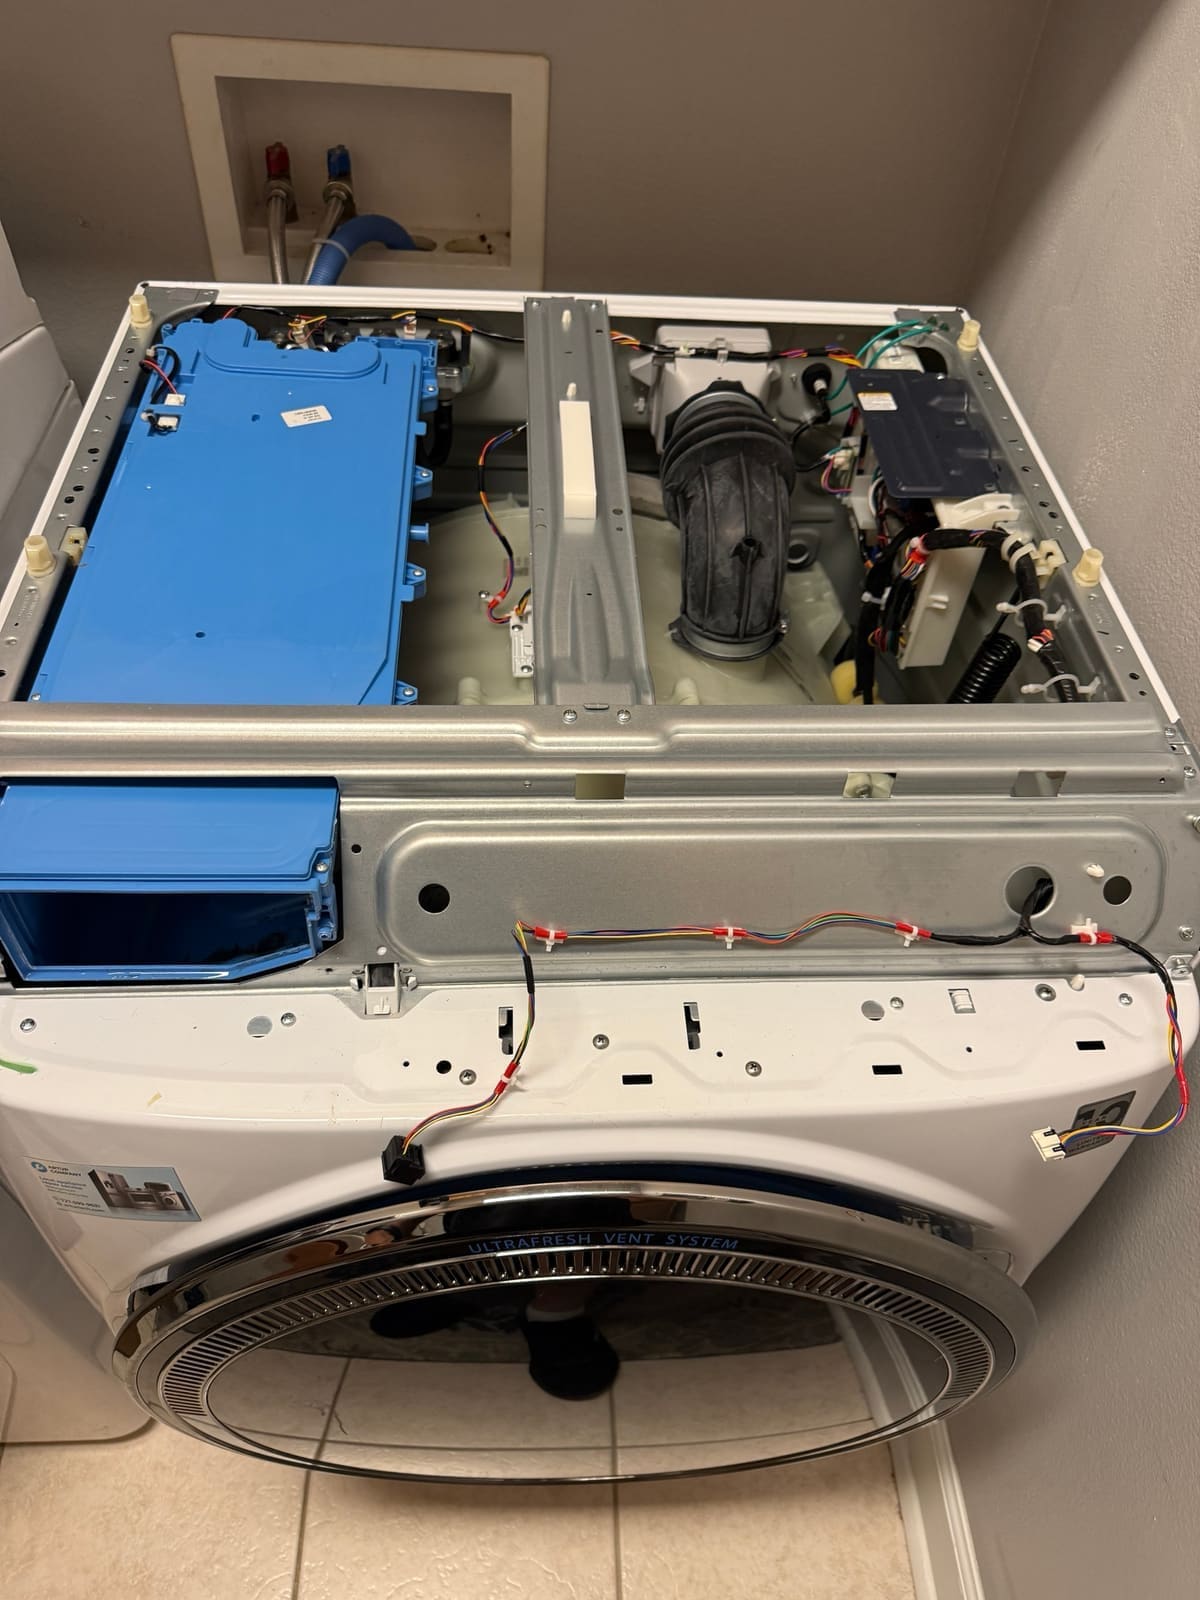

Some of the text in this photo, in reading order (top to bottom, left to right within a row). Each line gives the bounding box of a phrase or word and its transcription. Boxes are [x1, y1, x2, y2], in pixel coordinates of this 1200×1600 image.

[468, 1233, 739, 1254] ULTRAFRESH VENT SYSTEM
